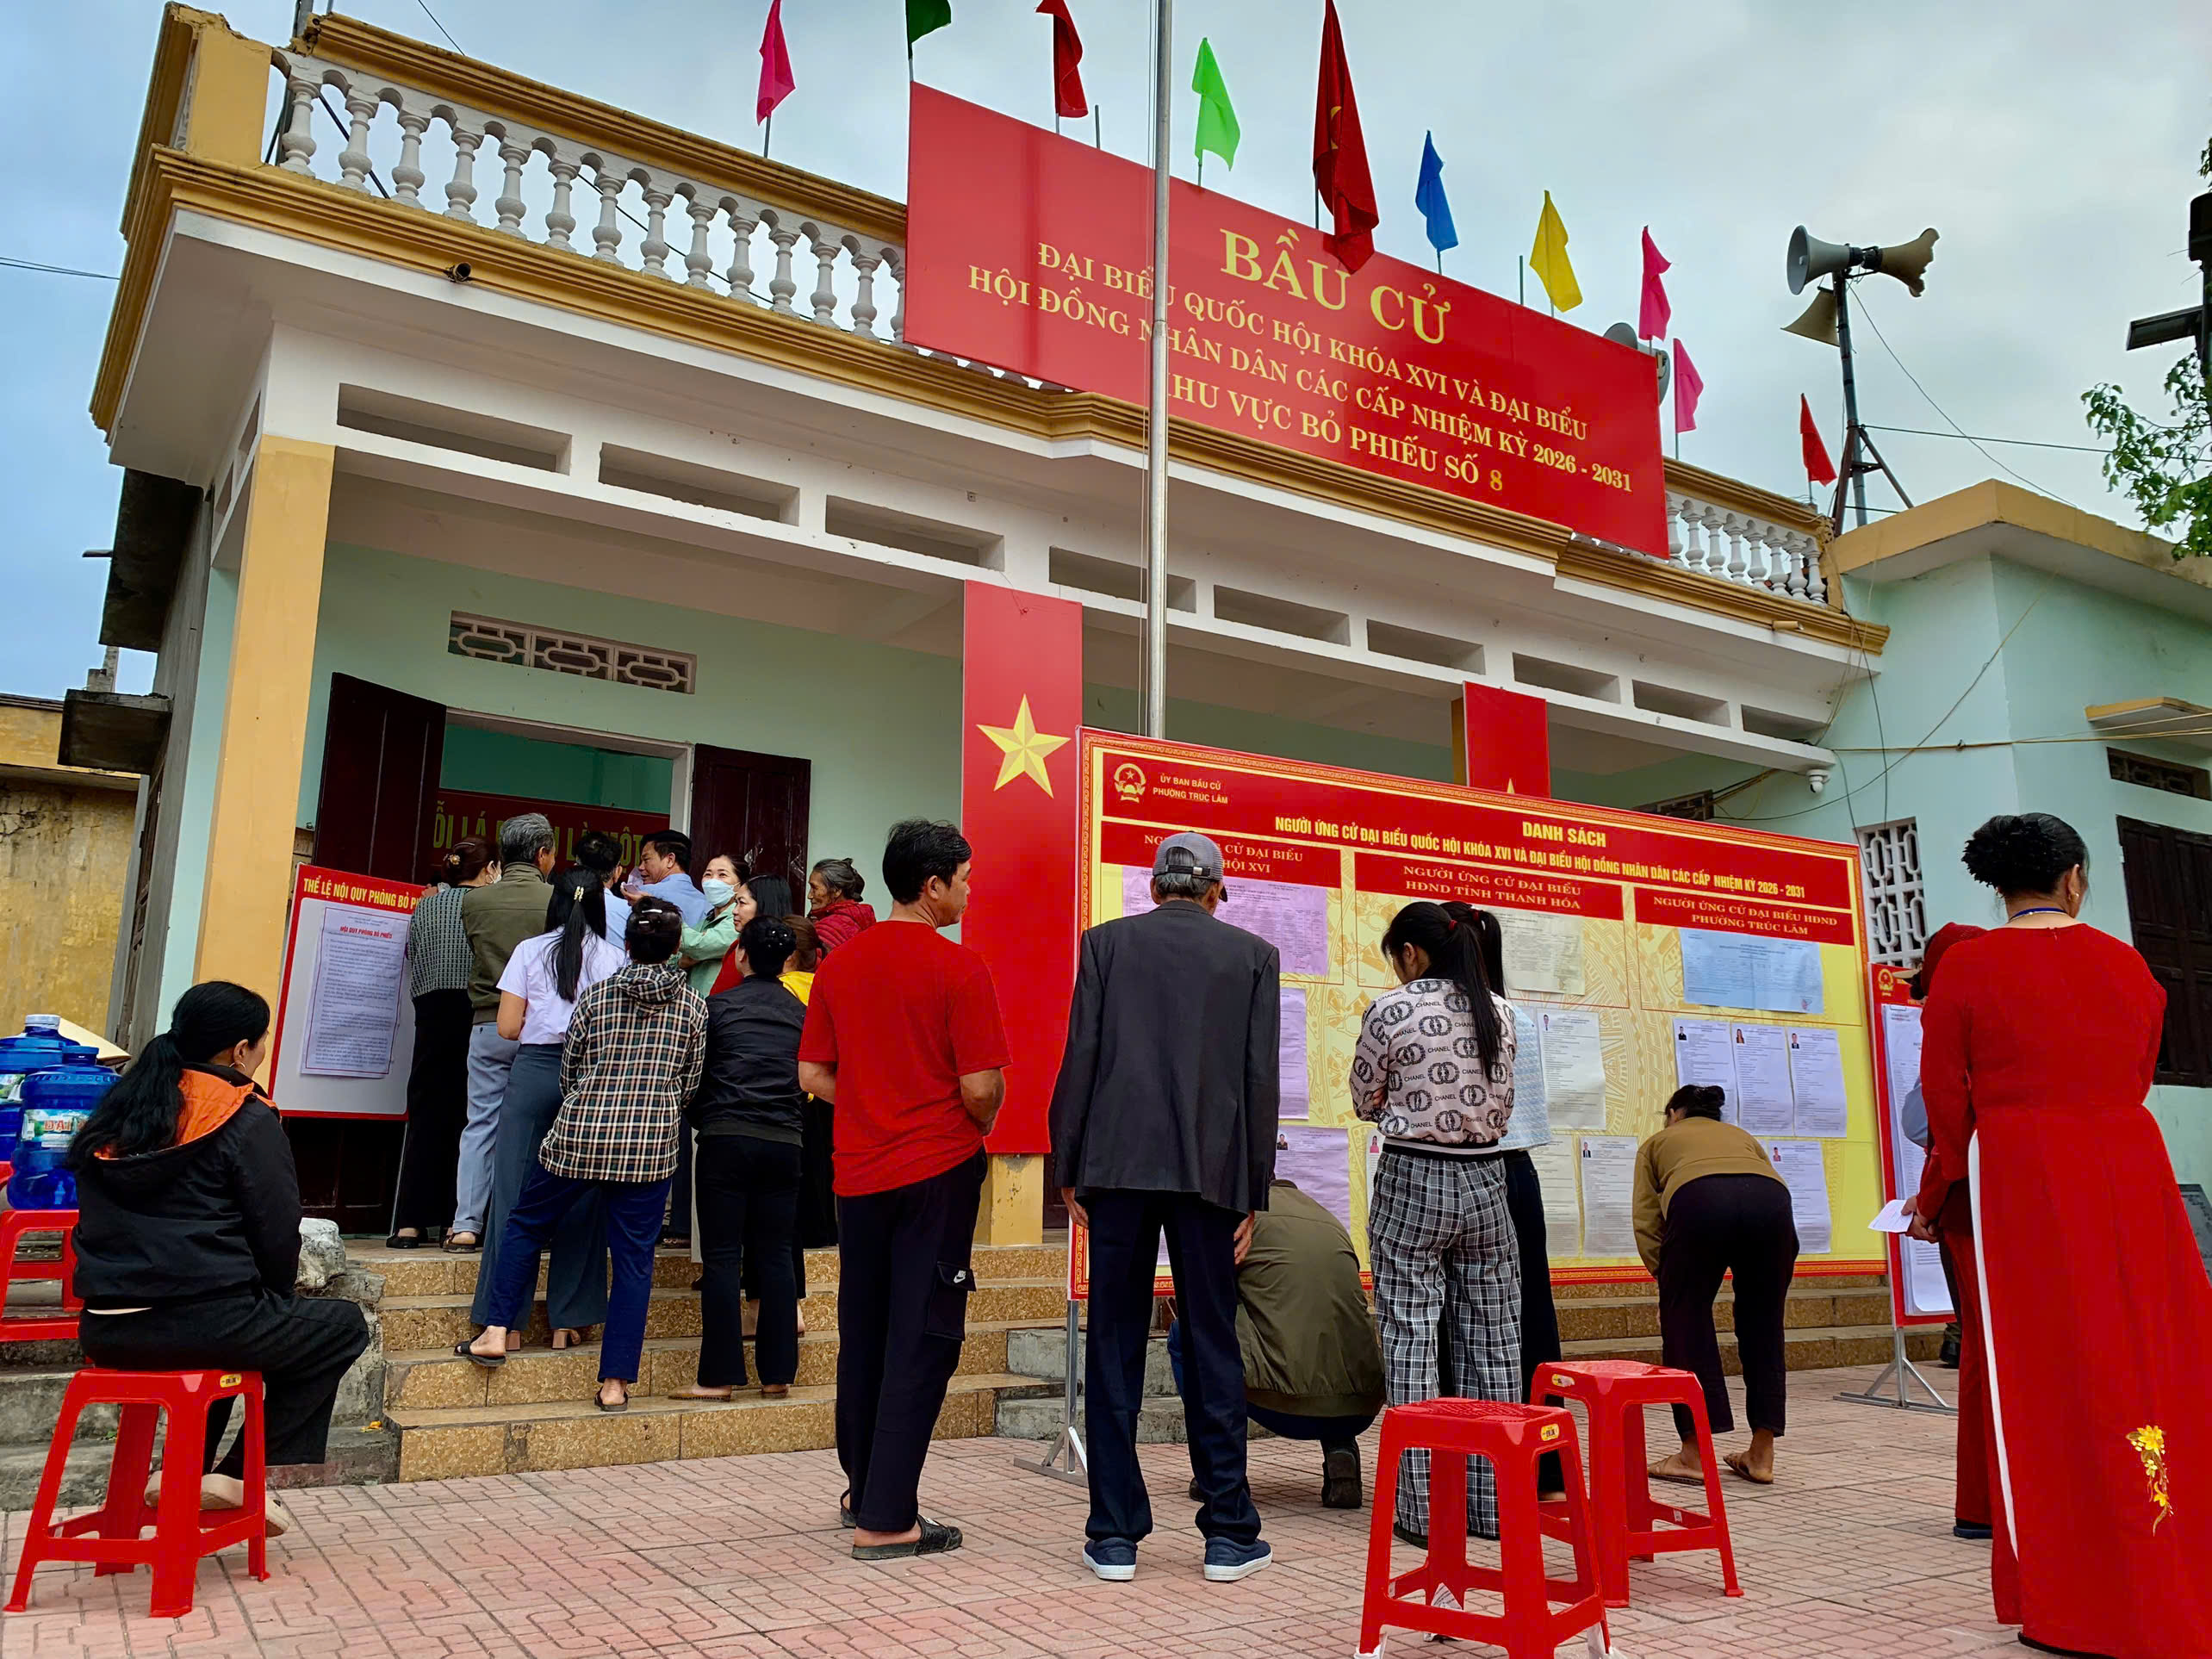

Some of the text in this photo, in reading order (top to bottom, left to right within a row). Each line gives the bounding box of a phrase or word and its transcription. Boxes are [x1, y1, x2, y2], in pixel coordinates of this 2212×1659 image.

[1219, 227, 1452, 345] BẦU CỬ
[1038, 242, 1095, 282] ĐẠI
[1184, 291, 1264, 335] QUỐC
[1272, 321, 1322, 355] HỘI
[1329, 337, 1401, 381] KHÓA
[1405, 362, 1448, 395] XVI
[1452, 377, 1485, 408] VÀ
[1489, 390, 1530, 424] ĐẠI
[1534, 404, 1588, 441] BIỂU
[968, 264, 1030, 307] HỘI
[1038, 286, 1130, 337] ĐỒNG
[1229, 345, 1288, 385] DÂN
[1296, 368, 1349, 403] CÁC
[1355, 385, 1406, 419] CẤP
[1411, 407, 1493, 448] NHIỆM
[1499, 430, 1528, 459] KỲ
[1532, 444, 1576, 474] 2026
[1591, 463, 1633, 493] 2031
[1167, 372, 1504, 491] HU VỰC BỎ PHIẾU SỐ 8
[1173, 777, 1190, 786] BAN
[1209, 780, 1221, 791] CỬ
[1522, 820, 1607, 848] DANH SÁCH
[1224, 842, 1303, 862] CỬ ĐẠI BIỂU
[1275, 816, 1312, 835] NGƯỜI
[1314, 818, 1339, 838] ỨNG
[1341, 822, 1359, 841] CỬ
[1360, 827, 1379, 846] ĐẠI
[1382, 826, 1407, 848] BIỂU
[1410, 831, 1439, 851] QUỐC
[1442, 836, 1461, 856] HỘI
[1463, 840, 1492, 859] KHÓA
[1494, 845, 1512, 861] XVI
[1513, 847, 1528, 863] VÀ
[1530, 850, 1547, 867] ĐẠI
[1549, 849, 1572, 868] BIỂU
[1575, 855, 1591, 873] HỘI
[1593, 855, 1620, 877] ĐỒNG
[1622, 861, 1649, 879] NHÂN
[1650, 865, 1670, 881] DÂN
[1672, 867, 1691, 884] CÁC
[1693, 868, 1711, 886] CẤP
[1713, 873, 1743, 892] NHIỆM
[1757, 881, 1779, 895] 2026
[1786, 885, 1805, 898] 2031
[1248, 862, 1271, 873] XVI
[1403, 865, 1582, 896] NGƯỜI ỨNG CỬ ĐẠI BIỂU
[303, 875, 321, 894] THỂ
[321, 880, 332, 898] LỆ
[332, 882, 349, 901] NỘI
[350, 886, 368, 903] QUY
[369, 888, 397, 907] PHÒNG
[398, 892, 409, 910] BỎ
[1405, 880, 1581, 909] HĐND TỈNH THANH HÓA
[1653, 896, 1838, 926] NGƯỜI ỨNG CỬ ĐẠI BIỂU HĐND
[1691, 914, 1809, 935] PHƯỜNG TRÚC LÂM
